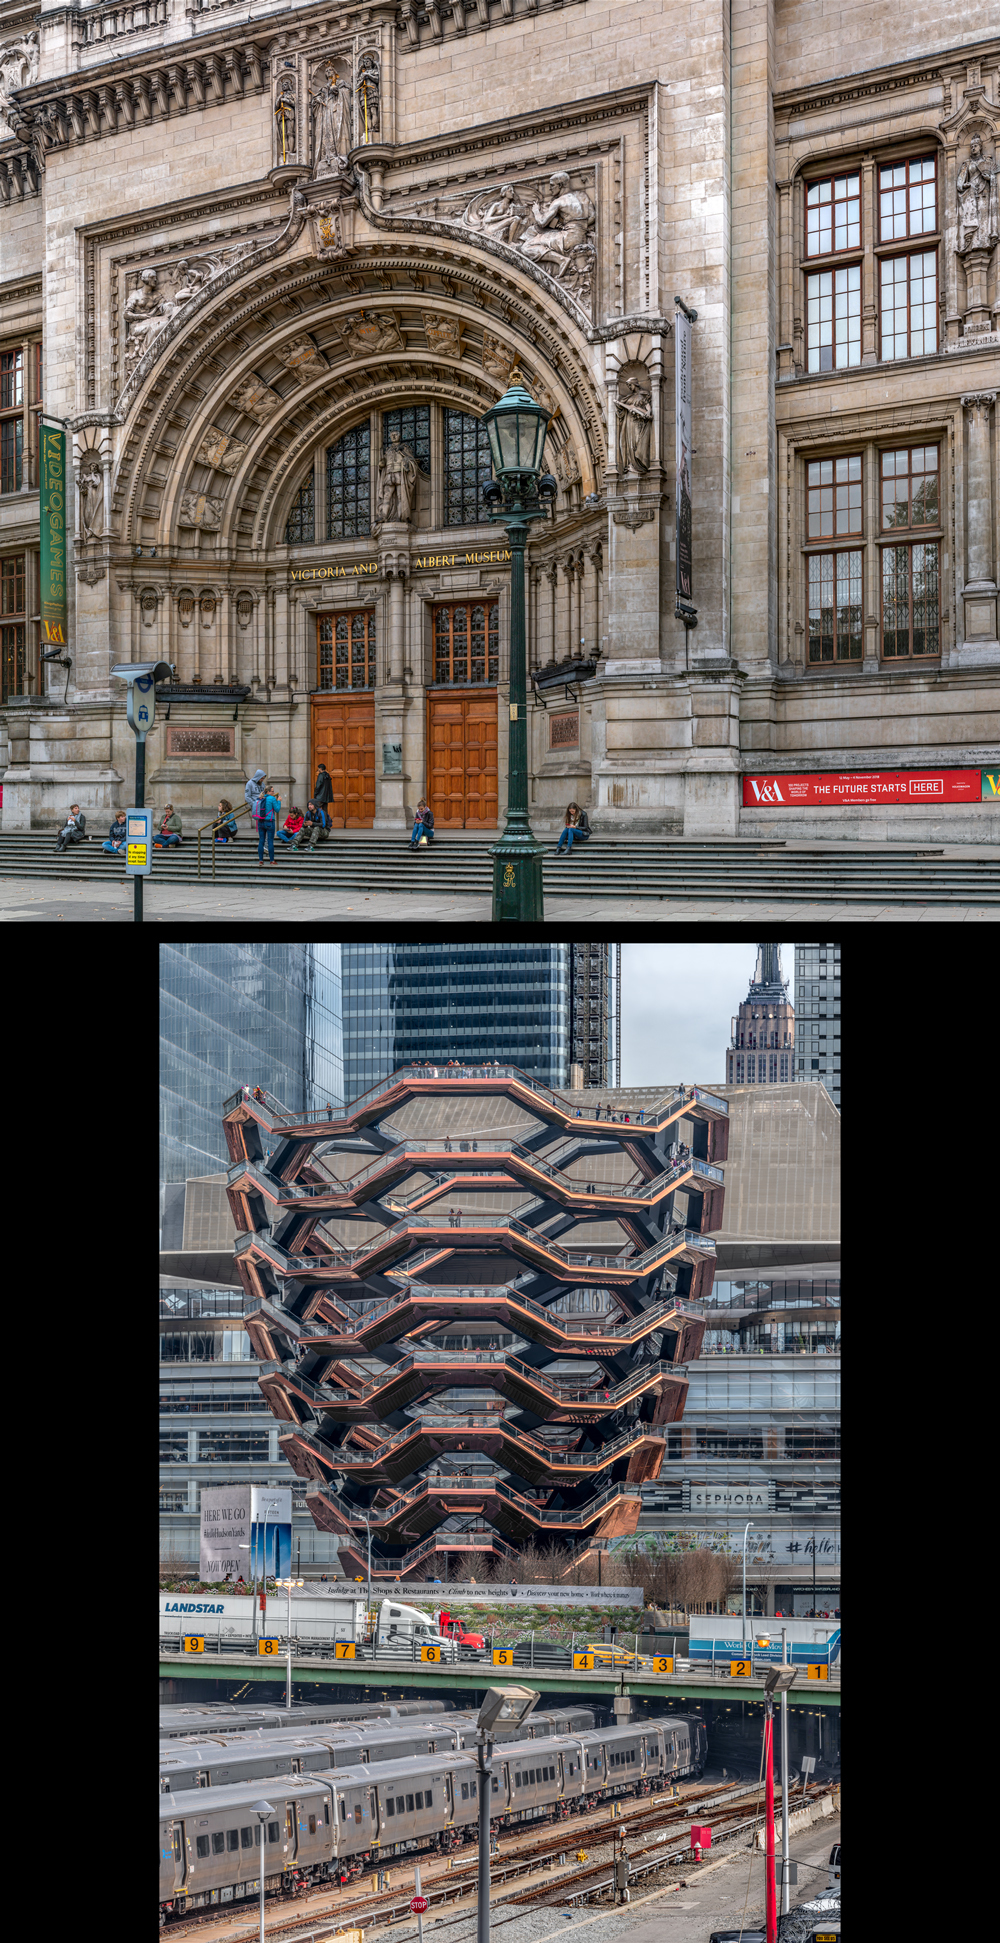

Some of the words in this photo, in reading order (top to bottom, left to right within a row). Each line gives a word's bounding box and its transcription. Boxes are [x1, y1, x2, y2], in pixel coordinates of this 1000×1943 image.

[48, 433, 64, 596] VIDEOGAMES
[416, 554, 458, 569] ALBERT
[465, 550, 512, 564] MUSEUM
[291, 566, 346, 581] VICTORIA
[352, 562, 378, 576] AND
[43, 620, 66, 642] V&A
[749, 780, 786, 802] V&A
[813, 786, 830, 794] THE
[833, 785, 868, 793] FUTURE
[871, 783, 907, 792] STARTS
[914, 783, 939, 792] HERE
[696, 1494, 763, 1504] SEPHORA
[204, 1509, 220, 1521] HERE
[222, 1508, 232, 1520] WE
[234, 1508, 245, 1520] GO
[206, 1560, 221, 1573] NOW
[222, 1560, 240, 1572] OPEN
[165, 1603, 224, 1614] LANDSTAR
[190, 1638, 198, 1650] 9
[265, 1641, 273, 1653] 8
[341, 1644, 349, 1657] 7
[426, 1648, 435, 1660] 6
[499, 1651, 507, 1664] 5
[579, 1655, 588, 1668] 4
[659, 1658, 667, 1671] 3
[736, 1662, 745, 1675] 2
[815, 1666, 820, 1678] 1
